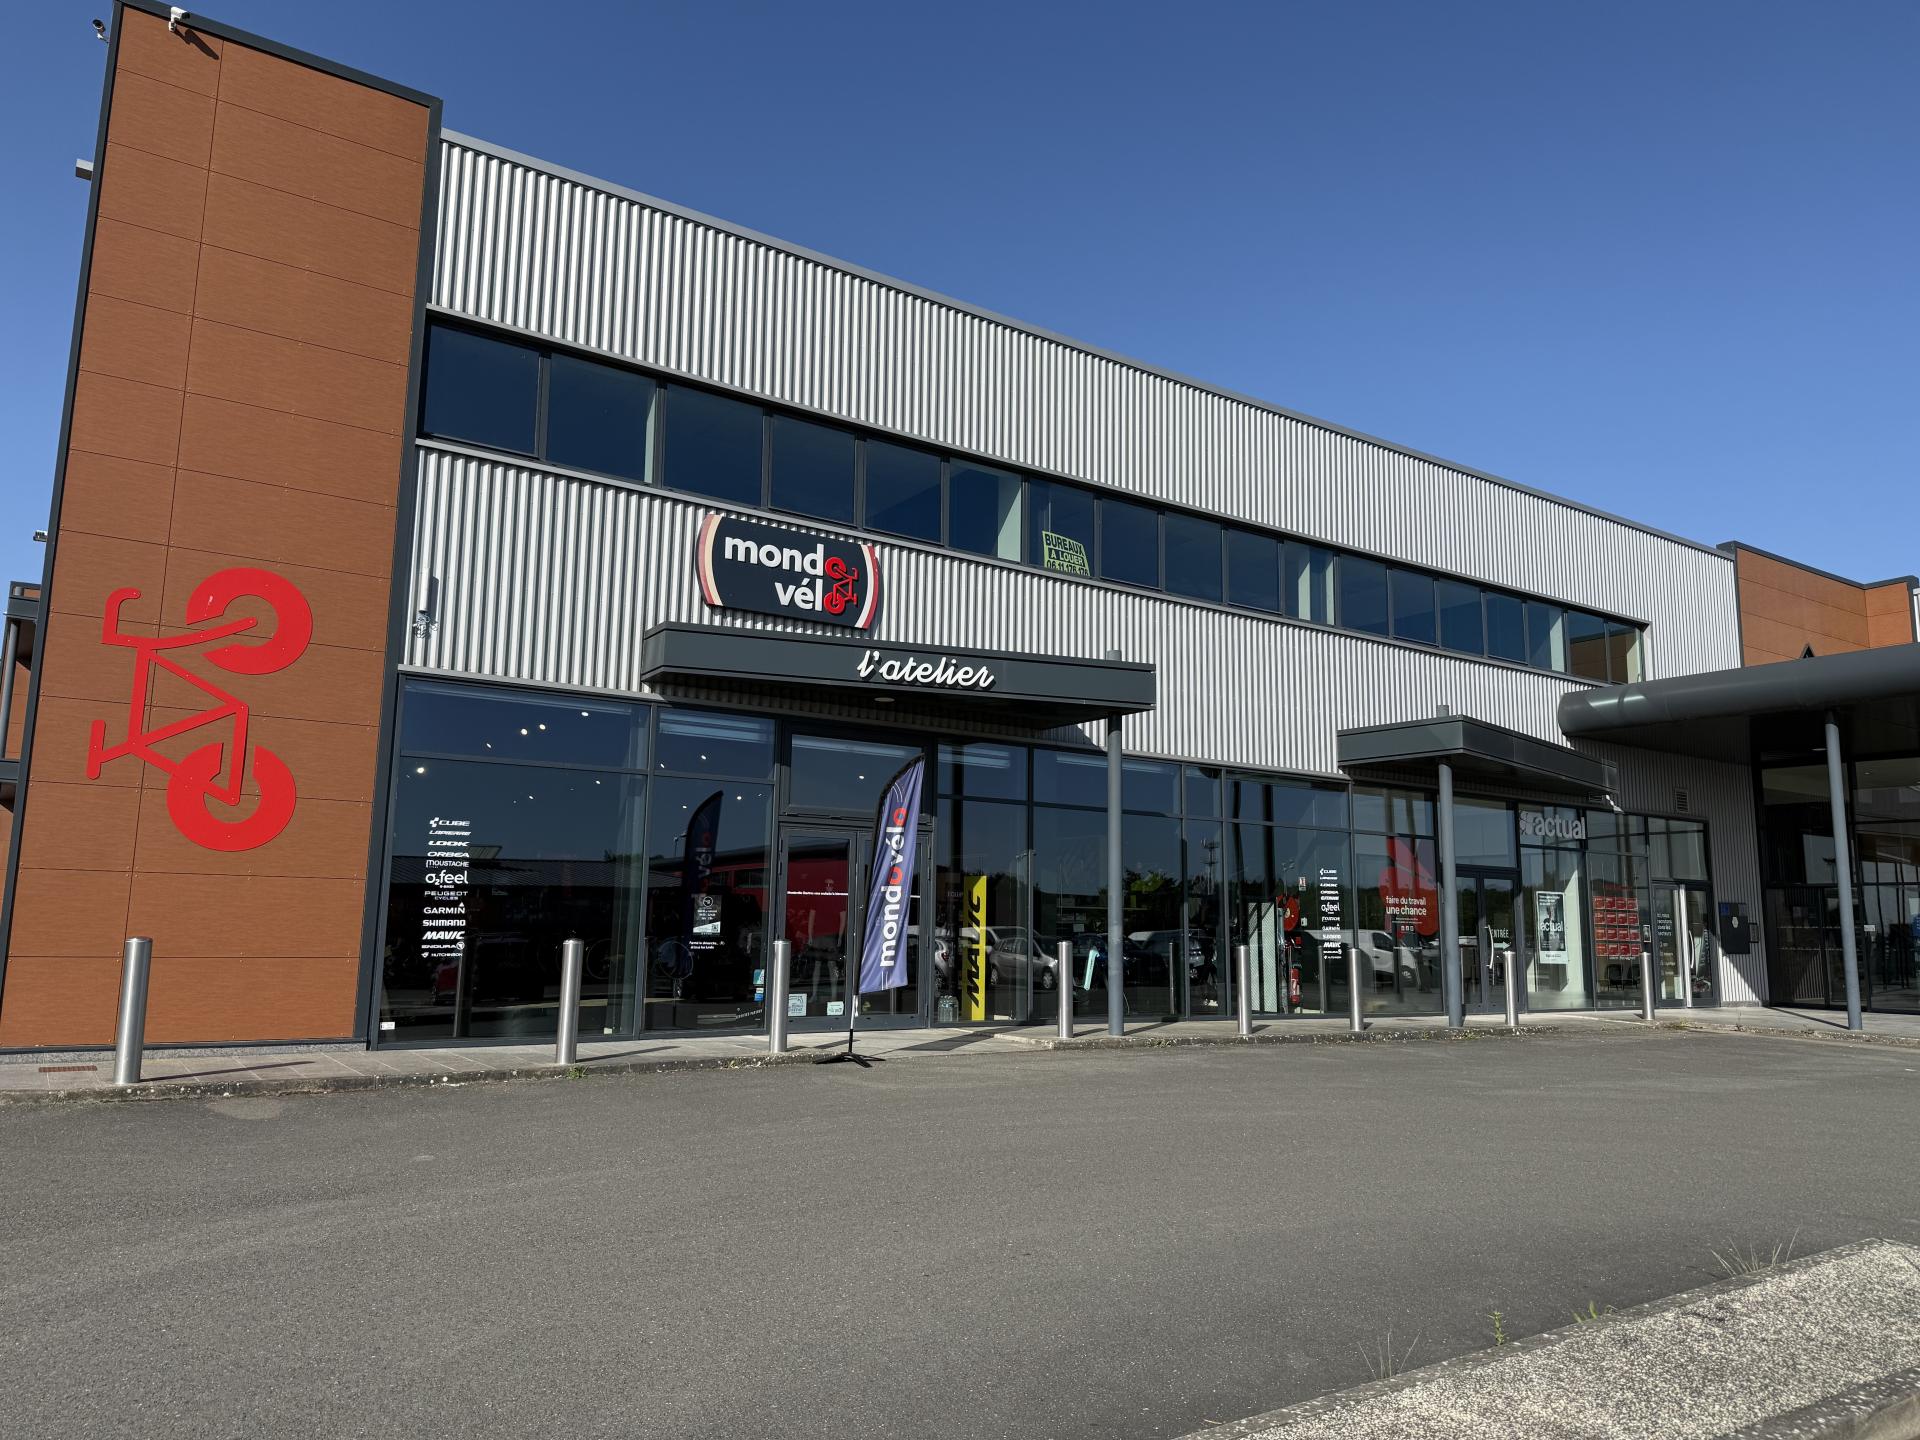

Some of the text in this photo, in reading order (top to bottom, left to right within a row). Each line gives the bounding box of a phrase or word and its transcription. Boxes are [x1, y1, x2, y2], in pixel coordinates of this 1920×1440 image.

[1045, 533, 1085, 557] BUREAUX
[1050, 549, 1084, 567] A LOUER
[857, 650, 994, 688] l'atelier
[1534, 813, 1586, 840] actual
[425, 859, 470, 868] MOUSTACHE
[1385, 895, 1427, 906] faire du travail
[1385, 905, 1427, 916] une chance
[422, 919, 466, 927] SHIMANO
[1540, 920, 1564, 932] actual
[422, 931, 465, 940] MAVIC
[967, 894, 982, 1009] MAVIC
